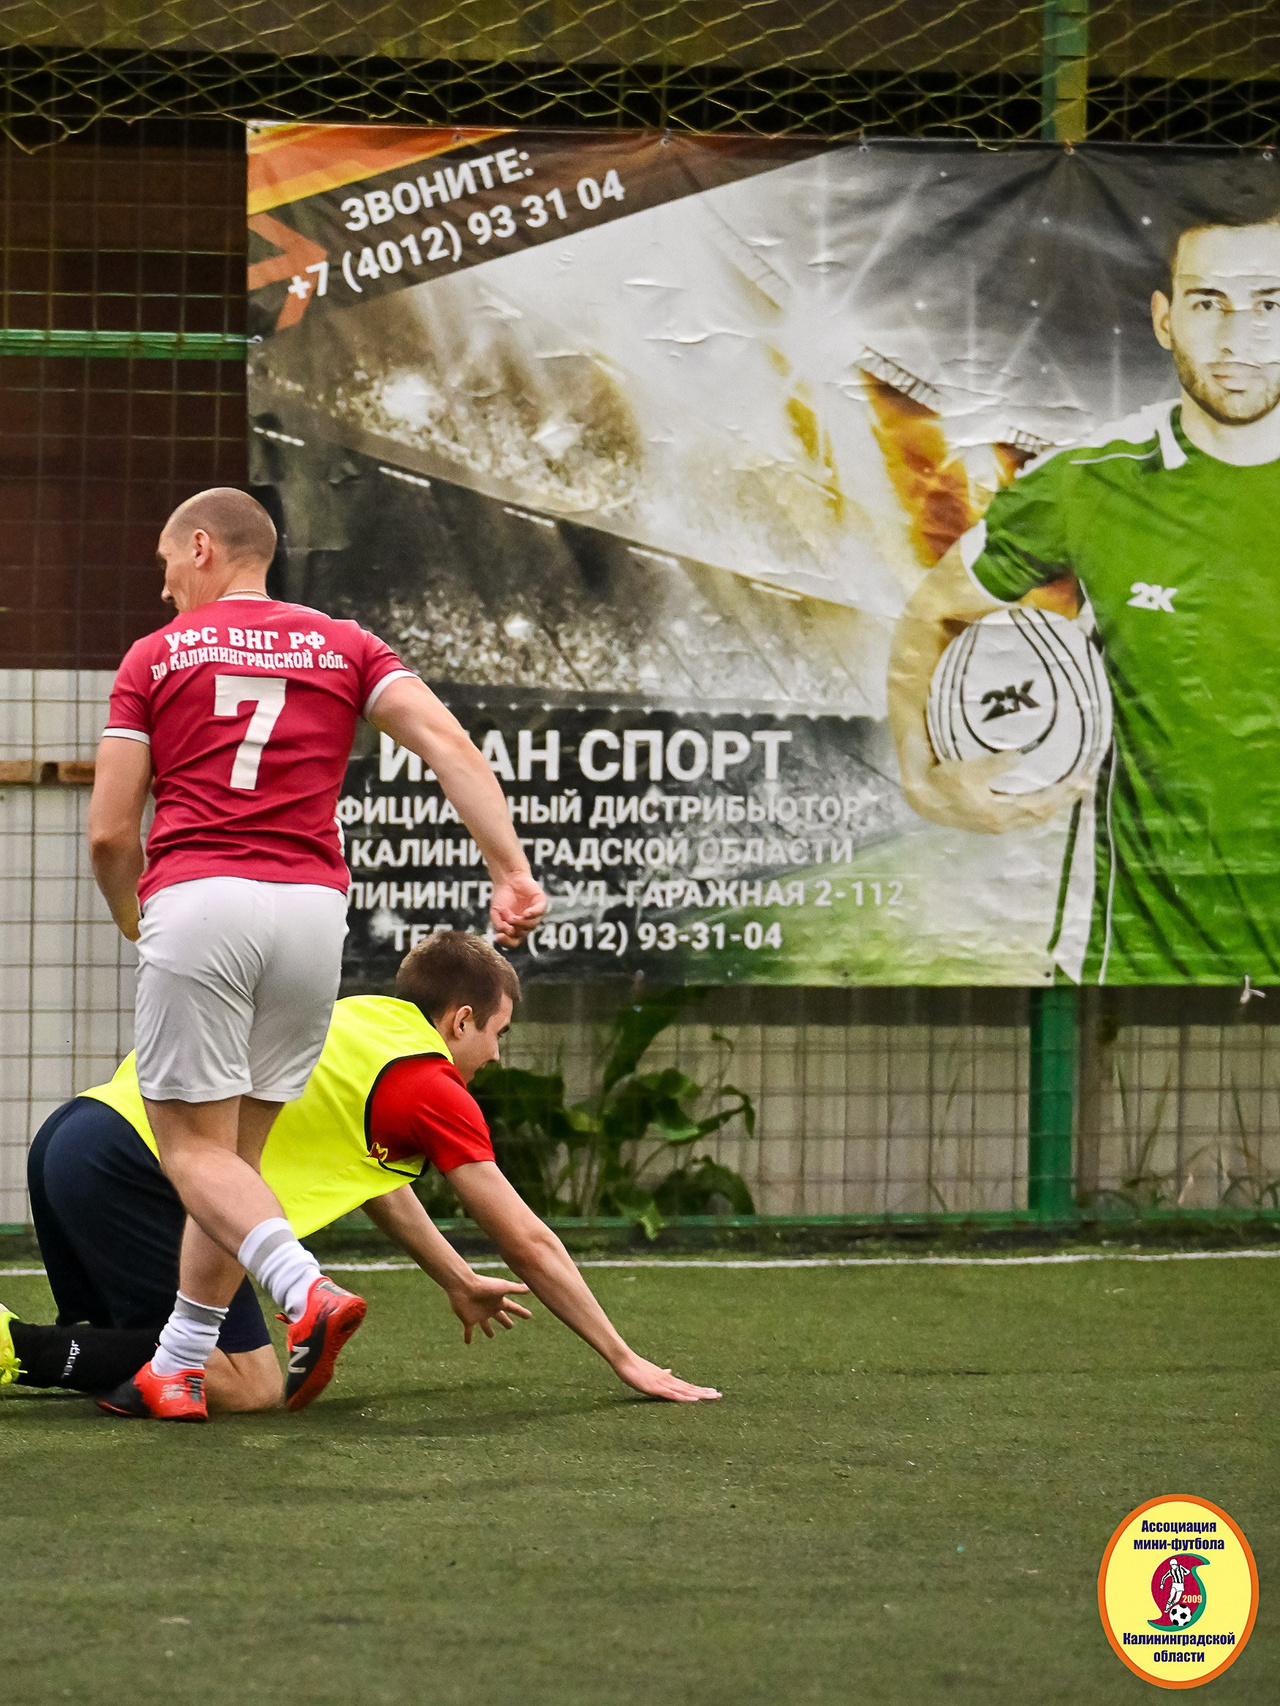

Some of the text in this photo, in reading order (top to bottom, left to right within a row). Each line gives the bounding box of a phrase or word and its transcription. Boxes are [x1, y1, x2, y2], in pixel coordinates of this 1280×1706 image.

[340, 147, 534, 231] ЗВОНИТЕ:
[287, 169, 625, 300] +7 (4012) 93 31 04
[164, 627, 326, 653] УФС ВНГ РФ
[170, 647, 314, 670] КАЛИНИНГРАДСКОЙ
[214, 675, 287, 790] 7
[379, 729, 792, 782] ИАН СПОРТ
[589, 795, 863, 829] ДИСТРИБЬЮТОР
[698, 837, 853, 865] ОБЛАСТИ
[627, 880, 805, 907] ГАРАЖНАЯ
[814, 881, 904, 906] 2-112
[527, 921, 628, 957] (4012)
[638, 922, 783, 951] 93-31-04
